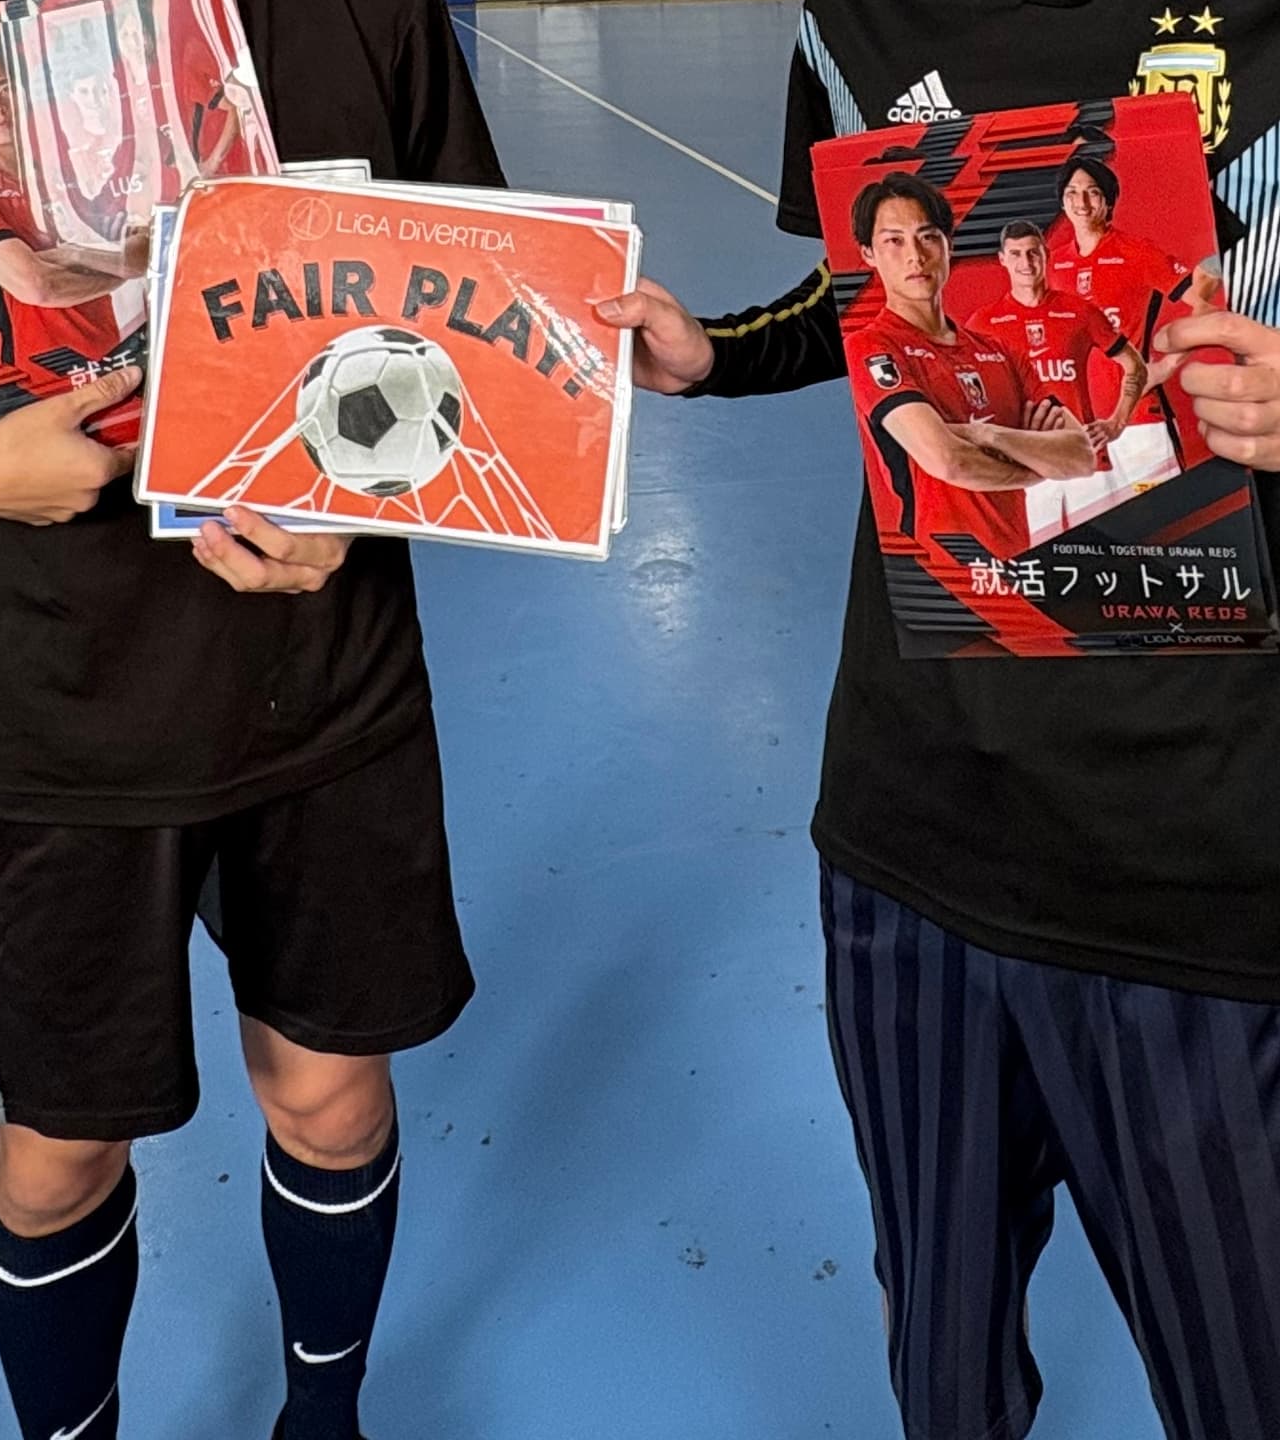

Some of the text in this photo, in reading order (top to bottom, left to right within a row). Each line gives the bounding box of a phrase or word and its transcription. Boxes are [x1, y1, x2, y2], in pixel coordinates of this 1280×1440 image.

[201, 260, 378, 342] FAIR
[1033, 359, 1077, 383] LUS
[1052, 543, 1238, 559] FOOTBALL TOGETHER URAWA REDS
[968, 557, 1251, 600] 就活フットサル
[1102, 605, 1249, 621] URAWA REDS
